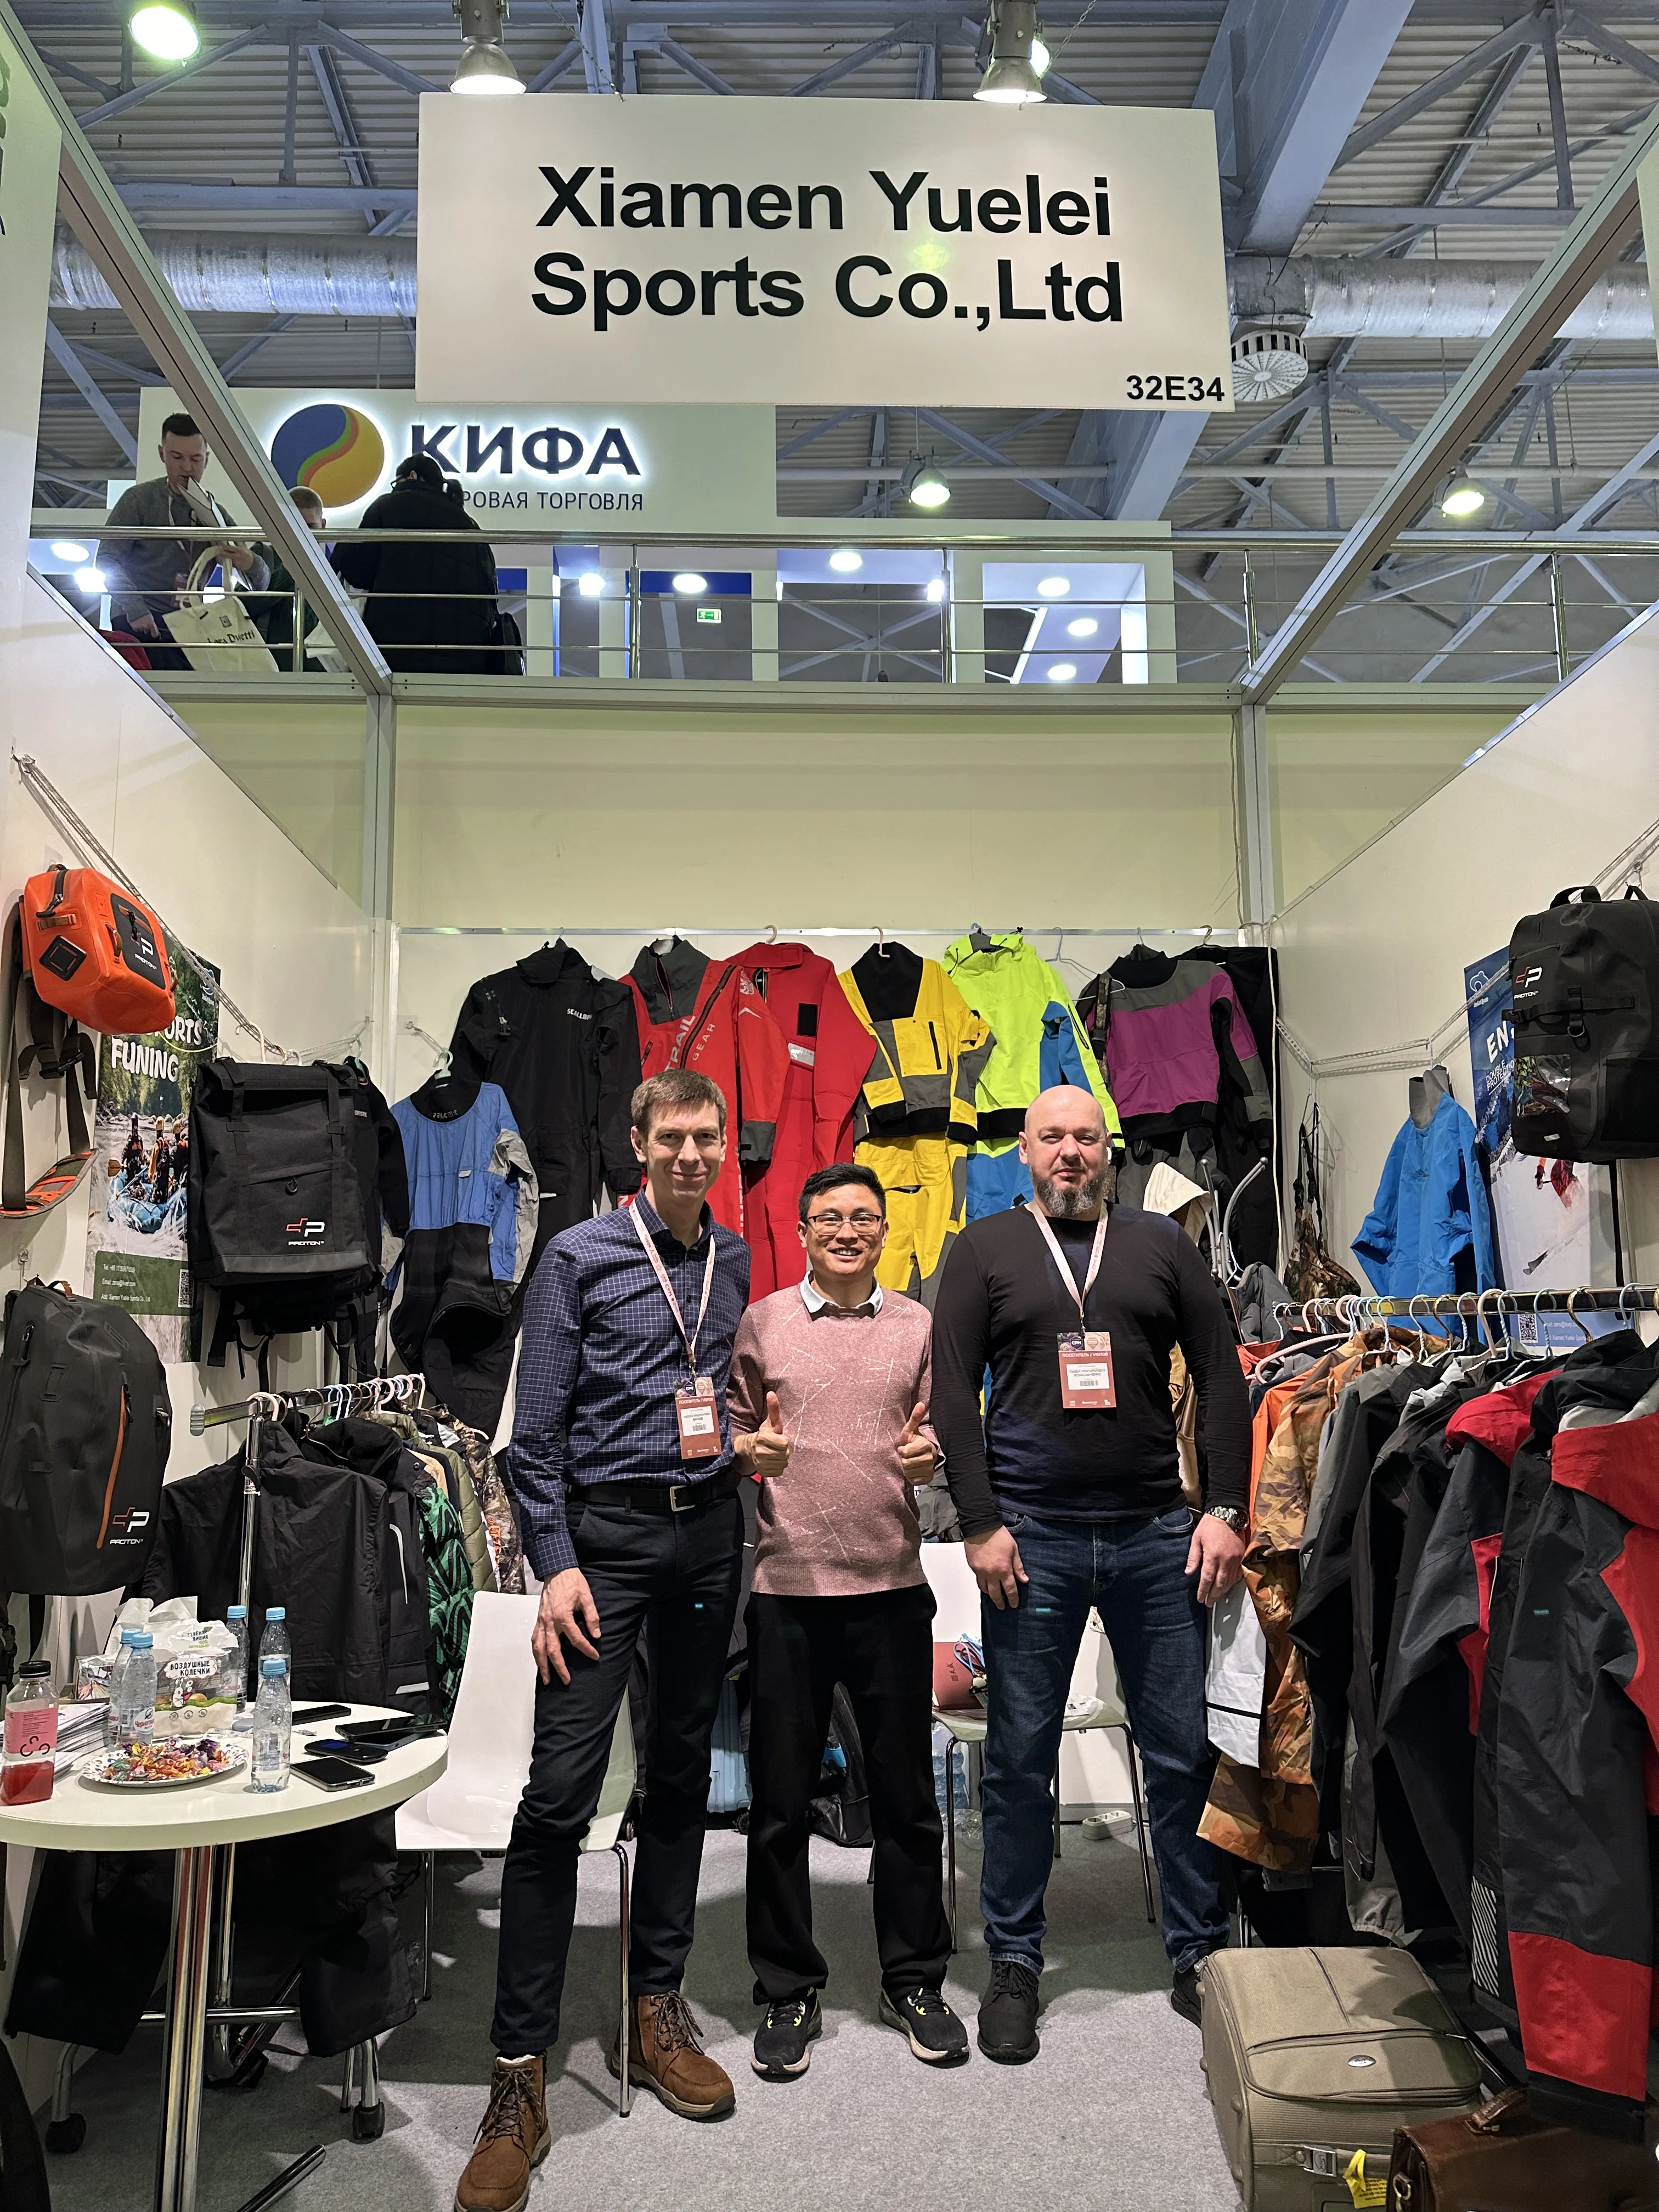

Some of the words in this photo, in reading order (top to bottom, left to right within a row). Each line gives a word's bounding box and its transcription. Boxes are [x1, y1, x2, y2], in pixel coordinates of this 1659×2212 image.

[536, 167, 843, 229] Xiamen
[869, 171, 1110, 236] Yuelei
[532, 252, 804, 331] Sports
[836, 256, 1122, 332] Co.,Ltd
[1126, 375, 1224, 403] 32E34
[411, 424, 642, 476] КИФА
[537, 492, 643, 510] ТОРГОВЛЯ
[692, 1023, 715, 1060] GEAR
[111, 1036, 179, 1082] FUNING
[1486, 1059, 1505, 1084] DOUBLE
[170, 1660, 210, 1671] ВОЗДУШНЫЕ
[180, 1667, 210, 1677] КОЛЕЧКИ
